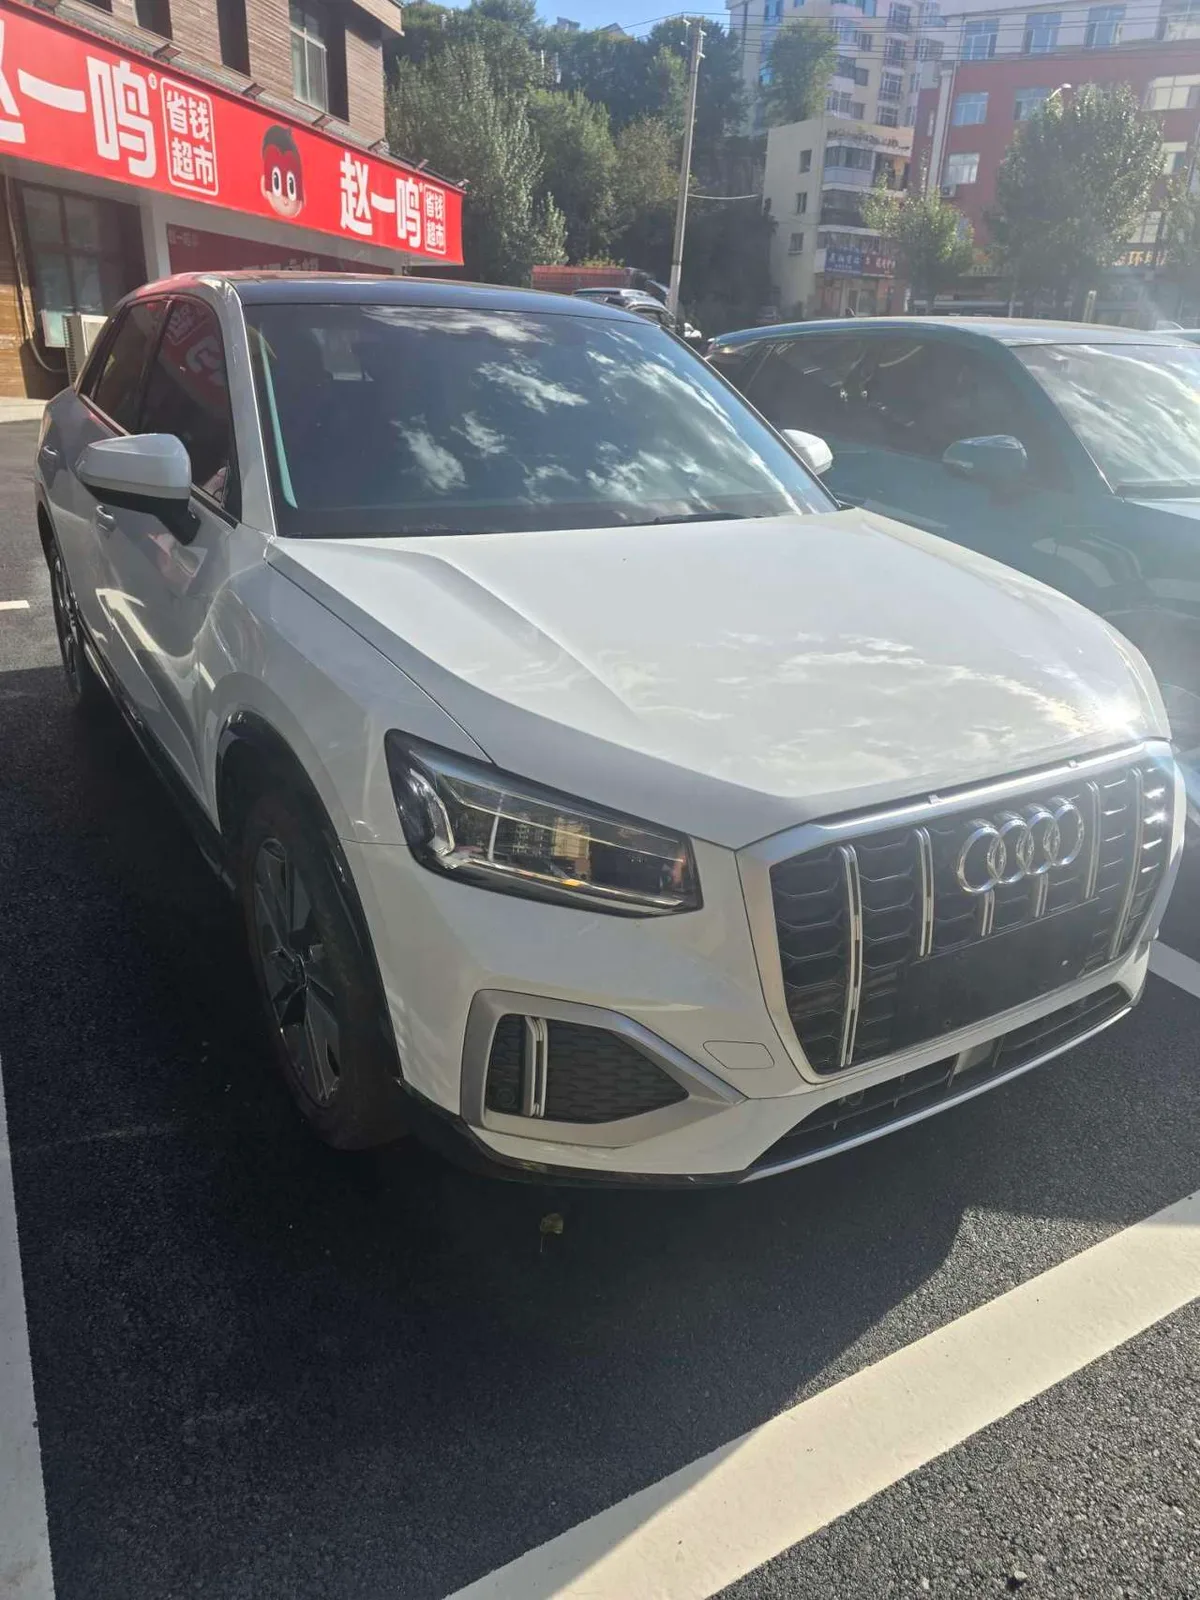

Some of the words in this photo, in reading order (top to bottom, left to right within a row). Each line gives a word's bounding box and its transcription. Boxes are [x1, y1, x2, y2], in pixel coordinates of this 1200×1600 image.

[0, 19, 156, 178] 一鸣
[167, 90, 210, 142] 省钱
[171, 136, 213, 184] 超市
[340, 151, 421, 248] 赵一鸣
[426, 191, 444, 220] 省钱
[427, 220, 444, 247] 超市
